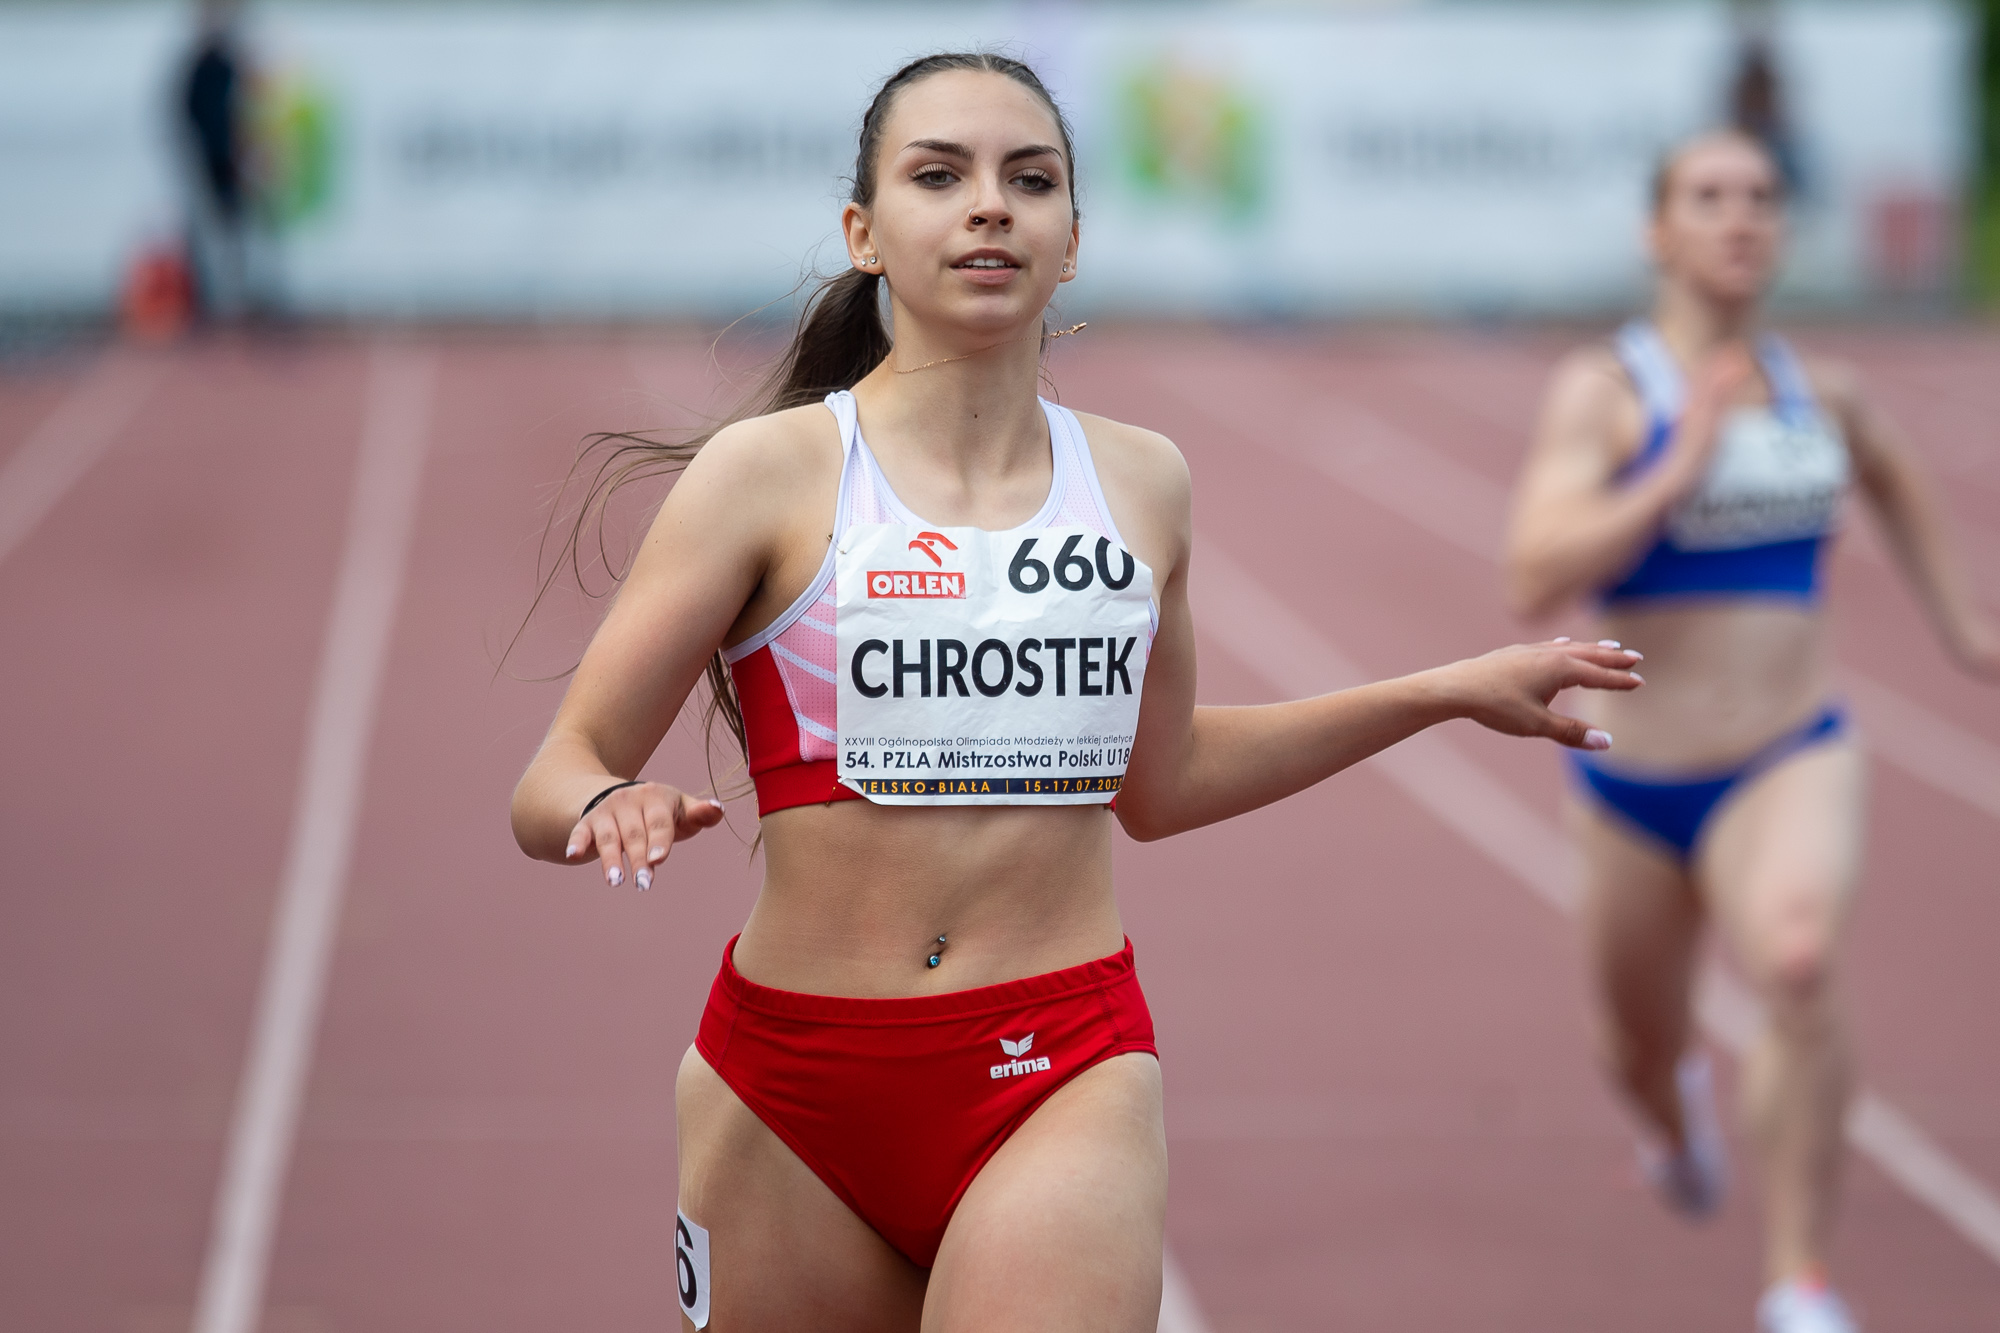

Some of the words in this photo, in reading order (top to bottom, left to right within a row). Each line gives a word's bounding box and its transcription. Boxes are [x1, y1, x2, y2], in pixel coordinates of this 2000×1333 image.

[1008, 534, 1135, 594] 660
[872, 574, 960, 595] ORLEN
[851, 637, 1138, 698] CHROSTEK
[845, 737, 875, 746] XXVIII
[878, 736, 953, 748] Ogólnopolska
[956, 735, 1011, 747] Olimpiada
[1014, 735, 1064, 747] Młodzieży
[1066, 737, 1075, 745] w
[1076, 735, 1101, 746] lekkiej
[1103, 734, 1133, 745] atletyce
[845, 752, 875, 768] 54.
[883, 752, 931, 769] PZLA
[937, 751, 1051, 769] Mistrzostwa
[1058, 748, 1103, 768] Polski
[1107, 748, 1130, 766] U18
[863, 781, 991, 794] IELSKO-BIAŁA
[990, 1056, 1051, 1079] erima
[676, 1214, 697, 1309] 6
